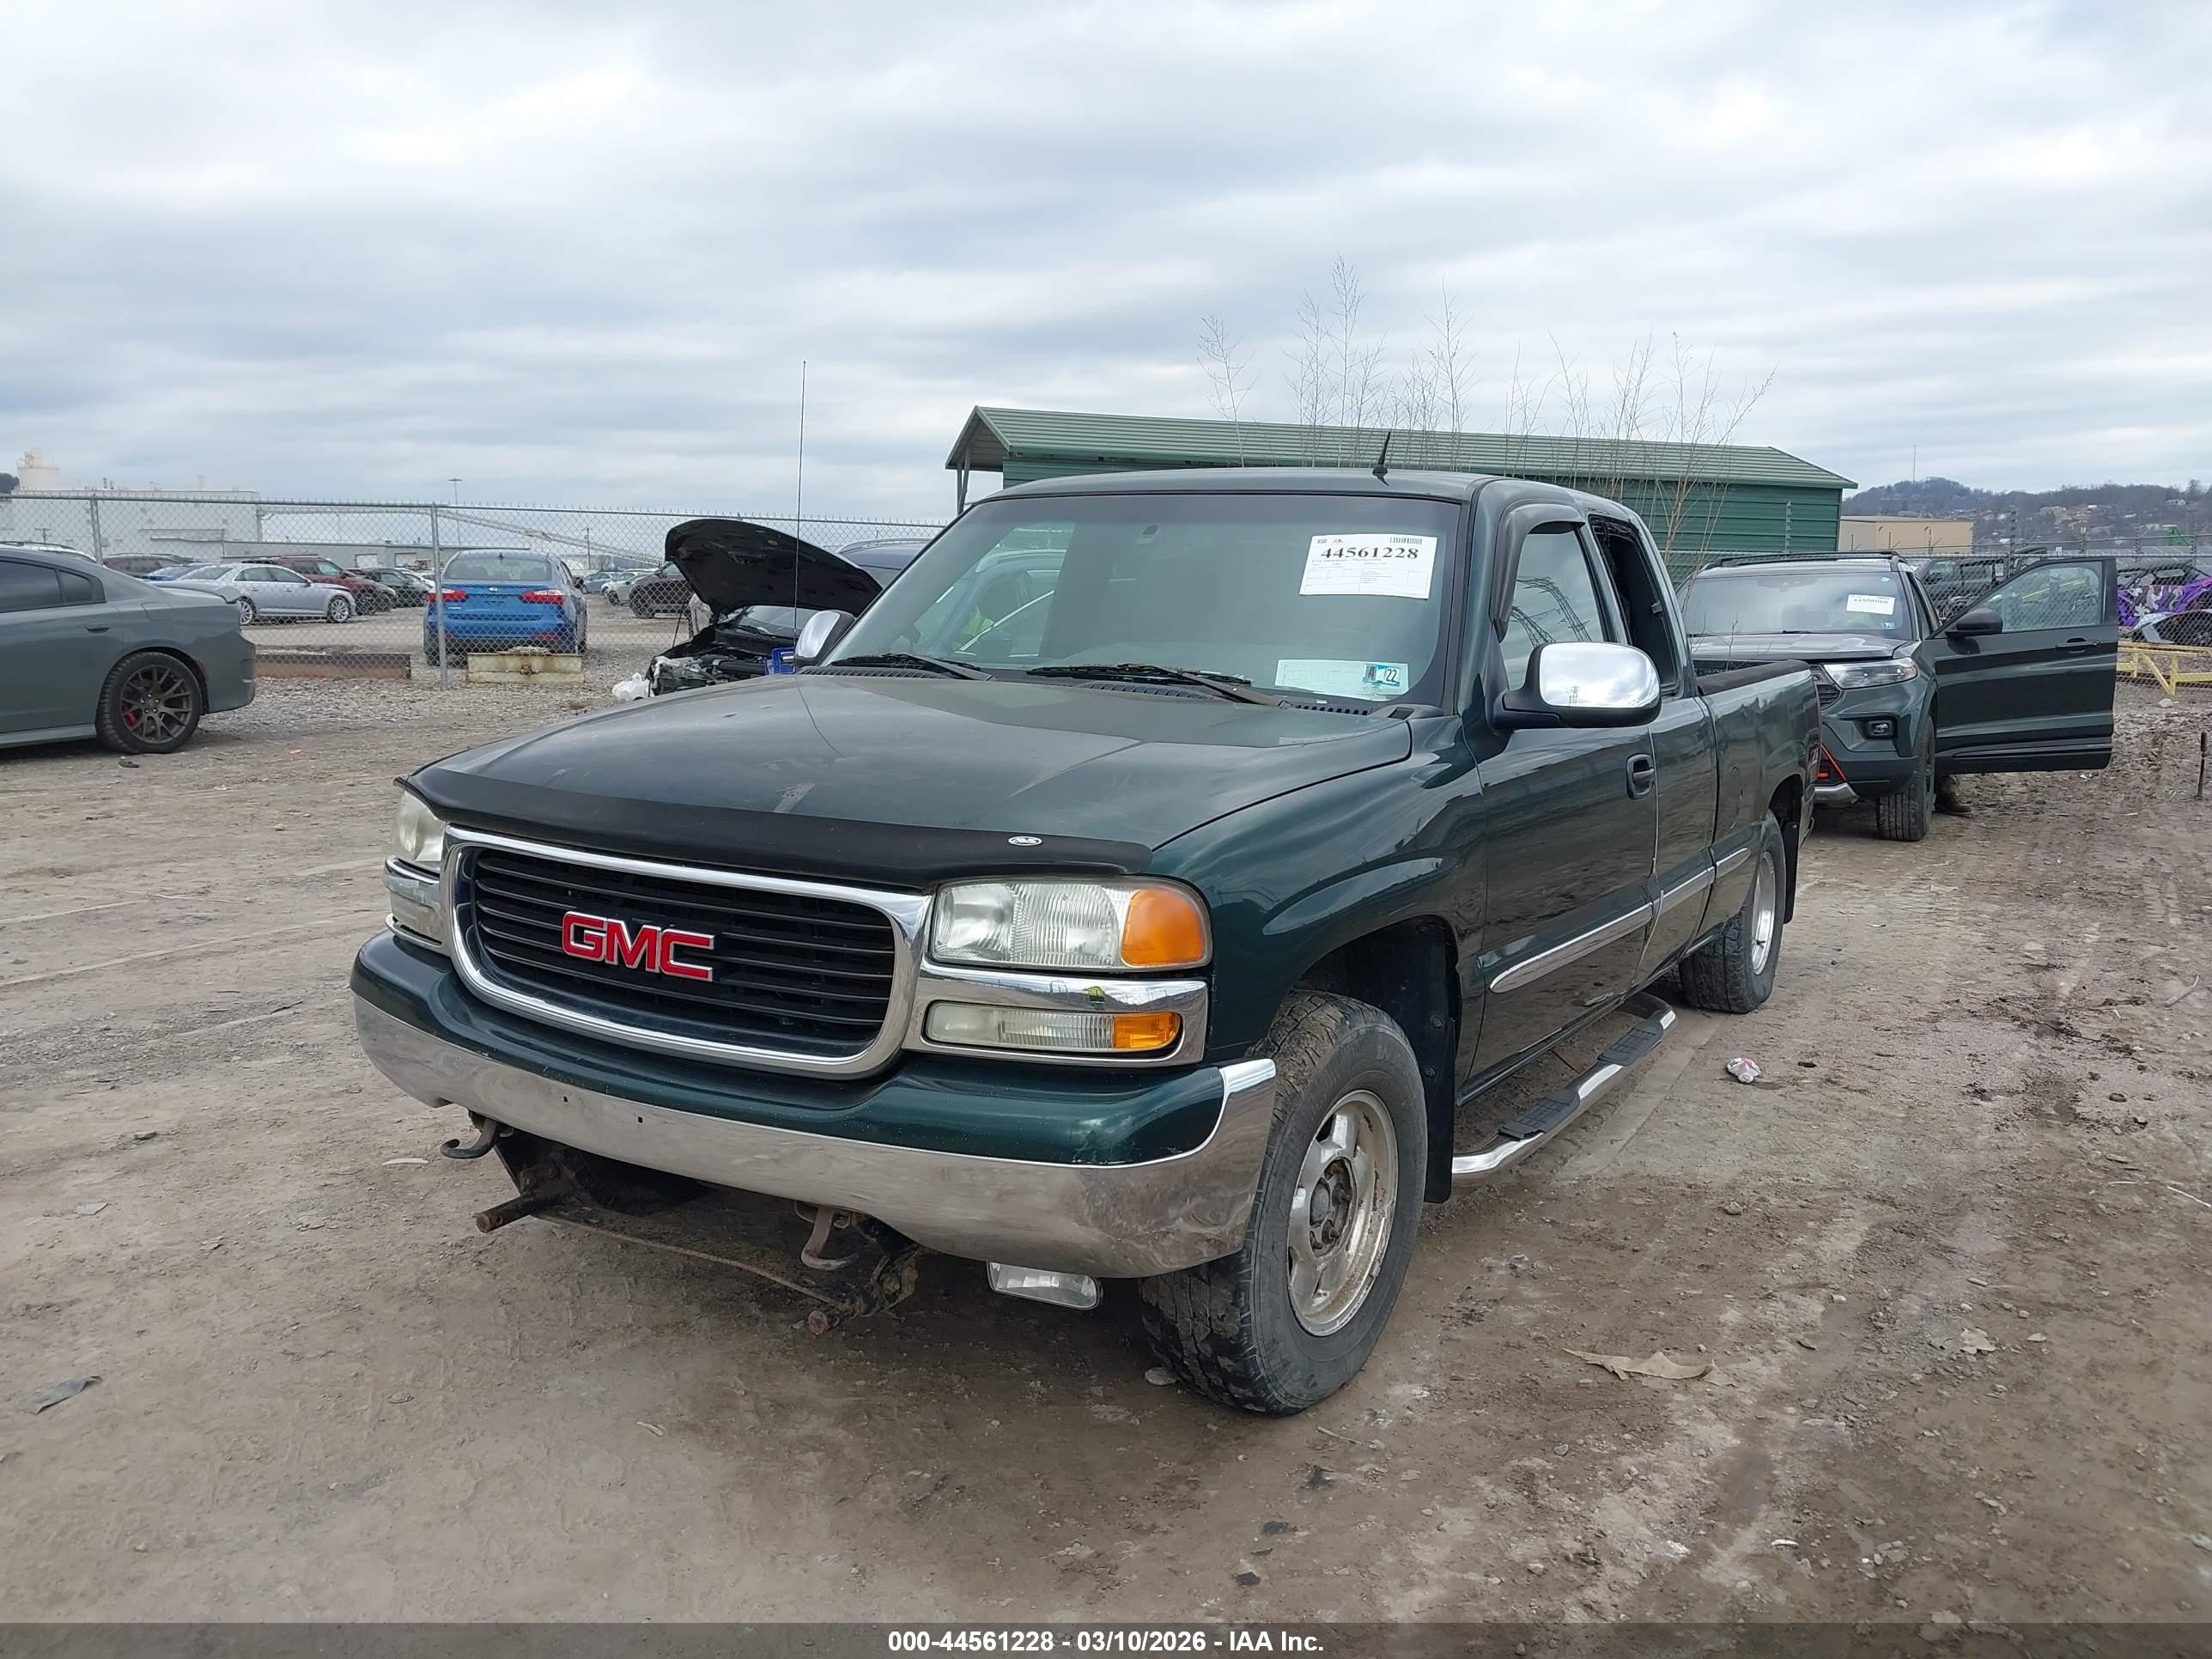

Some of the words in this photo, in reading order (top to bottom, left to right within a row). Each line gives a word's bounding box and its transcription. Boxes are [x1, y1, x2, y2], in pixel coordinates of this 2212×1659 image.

[1321, 547, 1419, 559] 44561228
[1385, 668, 1397, 683] 22
[562, 910, 715, 982] GMC
